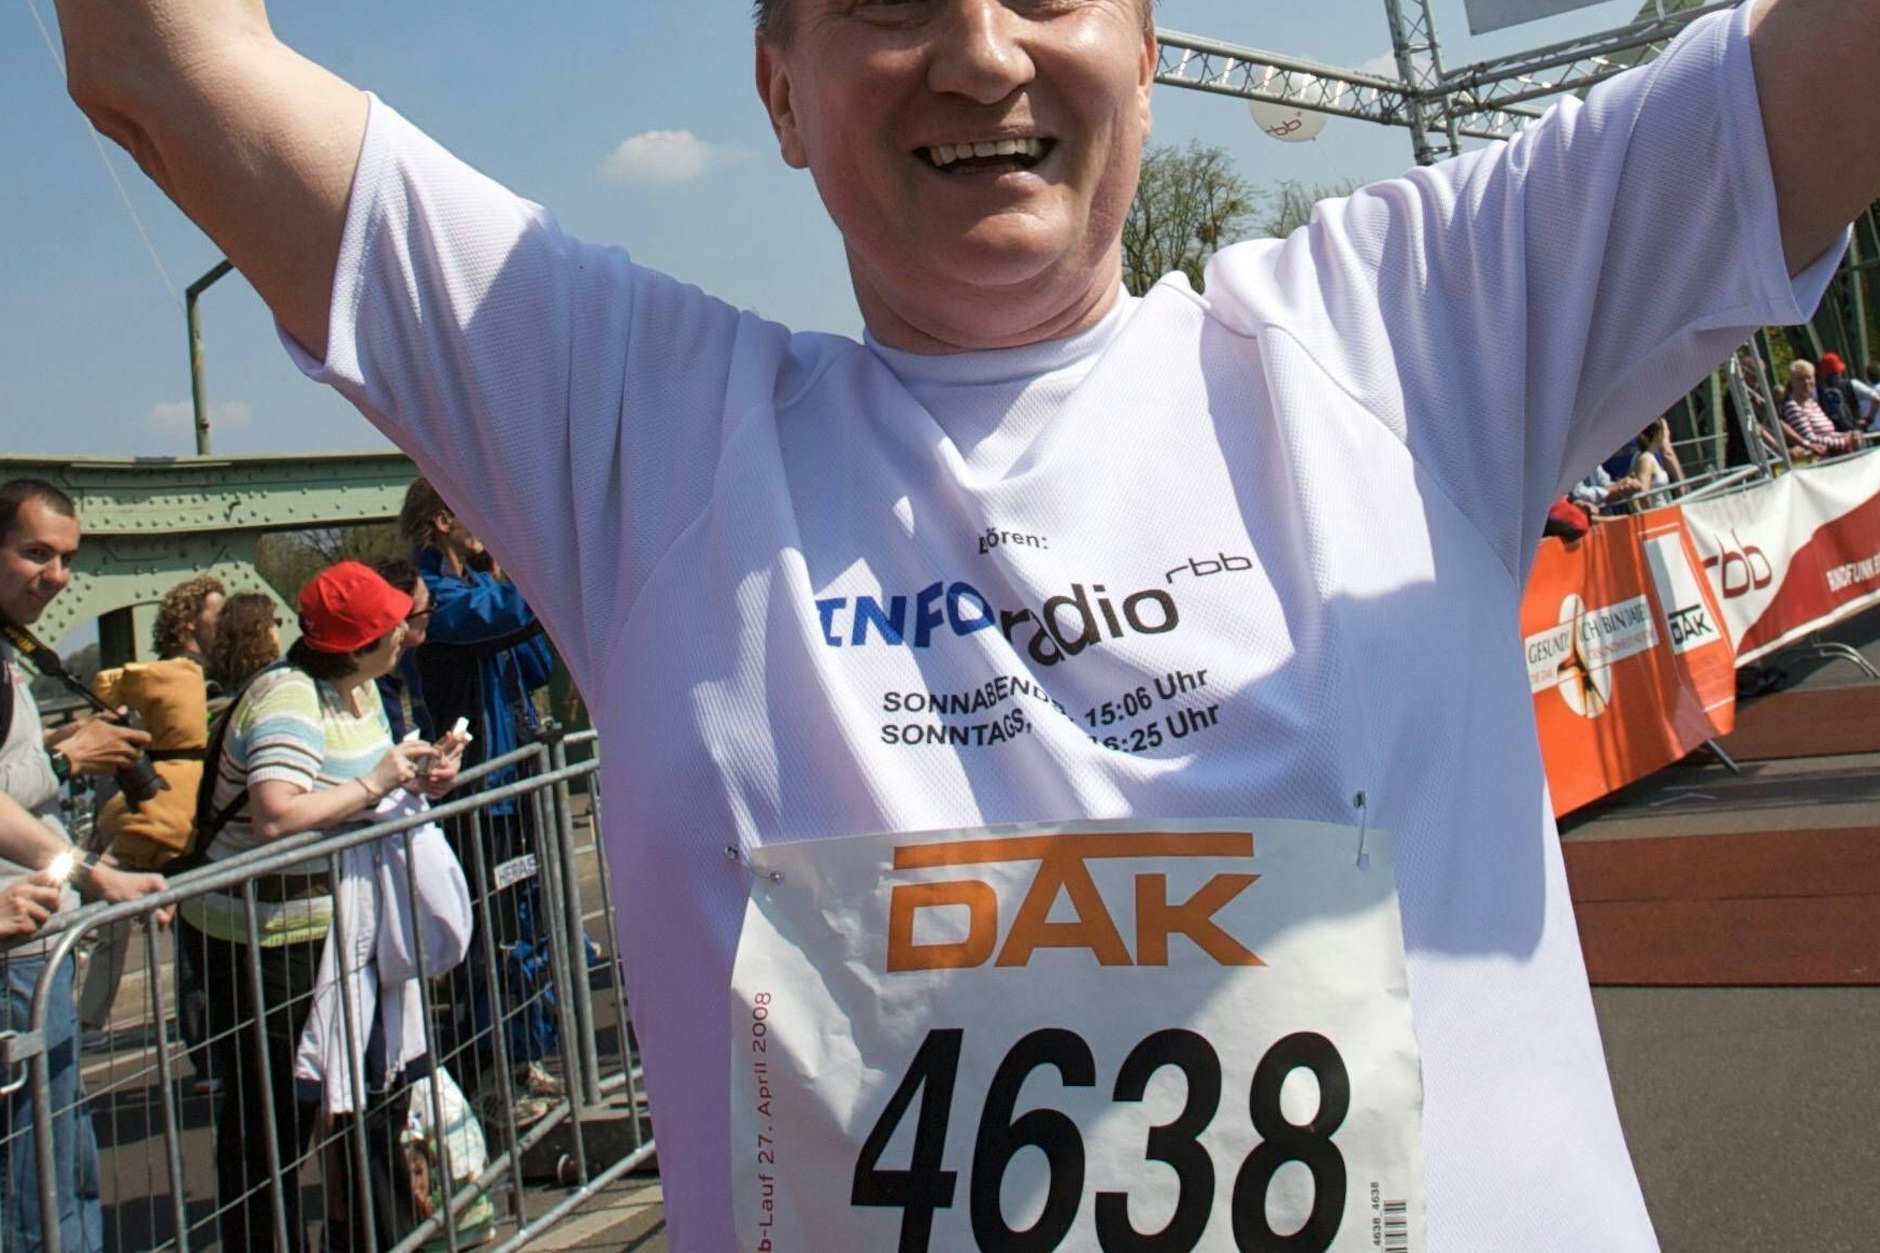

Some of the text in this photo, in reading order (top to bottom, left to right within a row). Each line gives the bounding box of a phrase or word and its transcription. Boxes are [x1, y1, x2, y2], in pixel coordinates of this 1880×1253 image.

[1166, 552, 1253, 584] rbb
[1667, 604, 1713, 645] DAK
[880, 707, 1033, 747] SONNTAGS,
[1166, 702, 1220, 740] Uhr
[1083, 686, 1152, 728] 15:06
[1153, 668, 1208, 700] Uhr
[886, 831, 1269, 973] DAK
[752, 991, 772, 1053] 2008
[754, 1062, 772, 1117] April
[757, 1125, 775, 1165] 27.
[850, 1026, 1351, 1253] 4638
